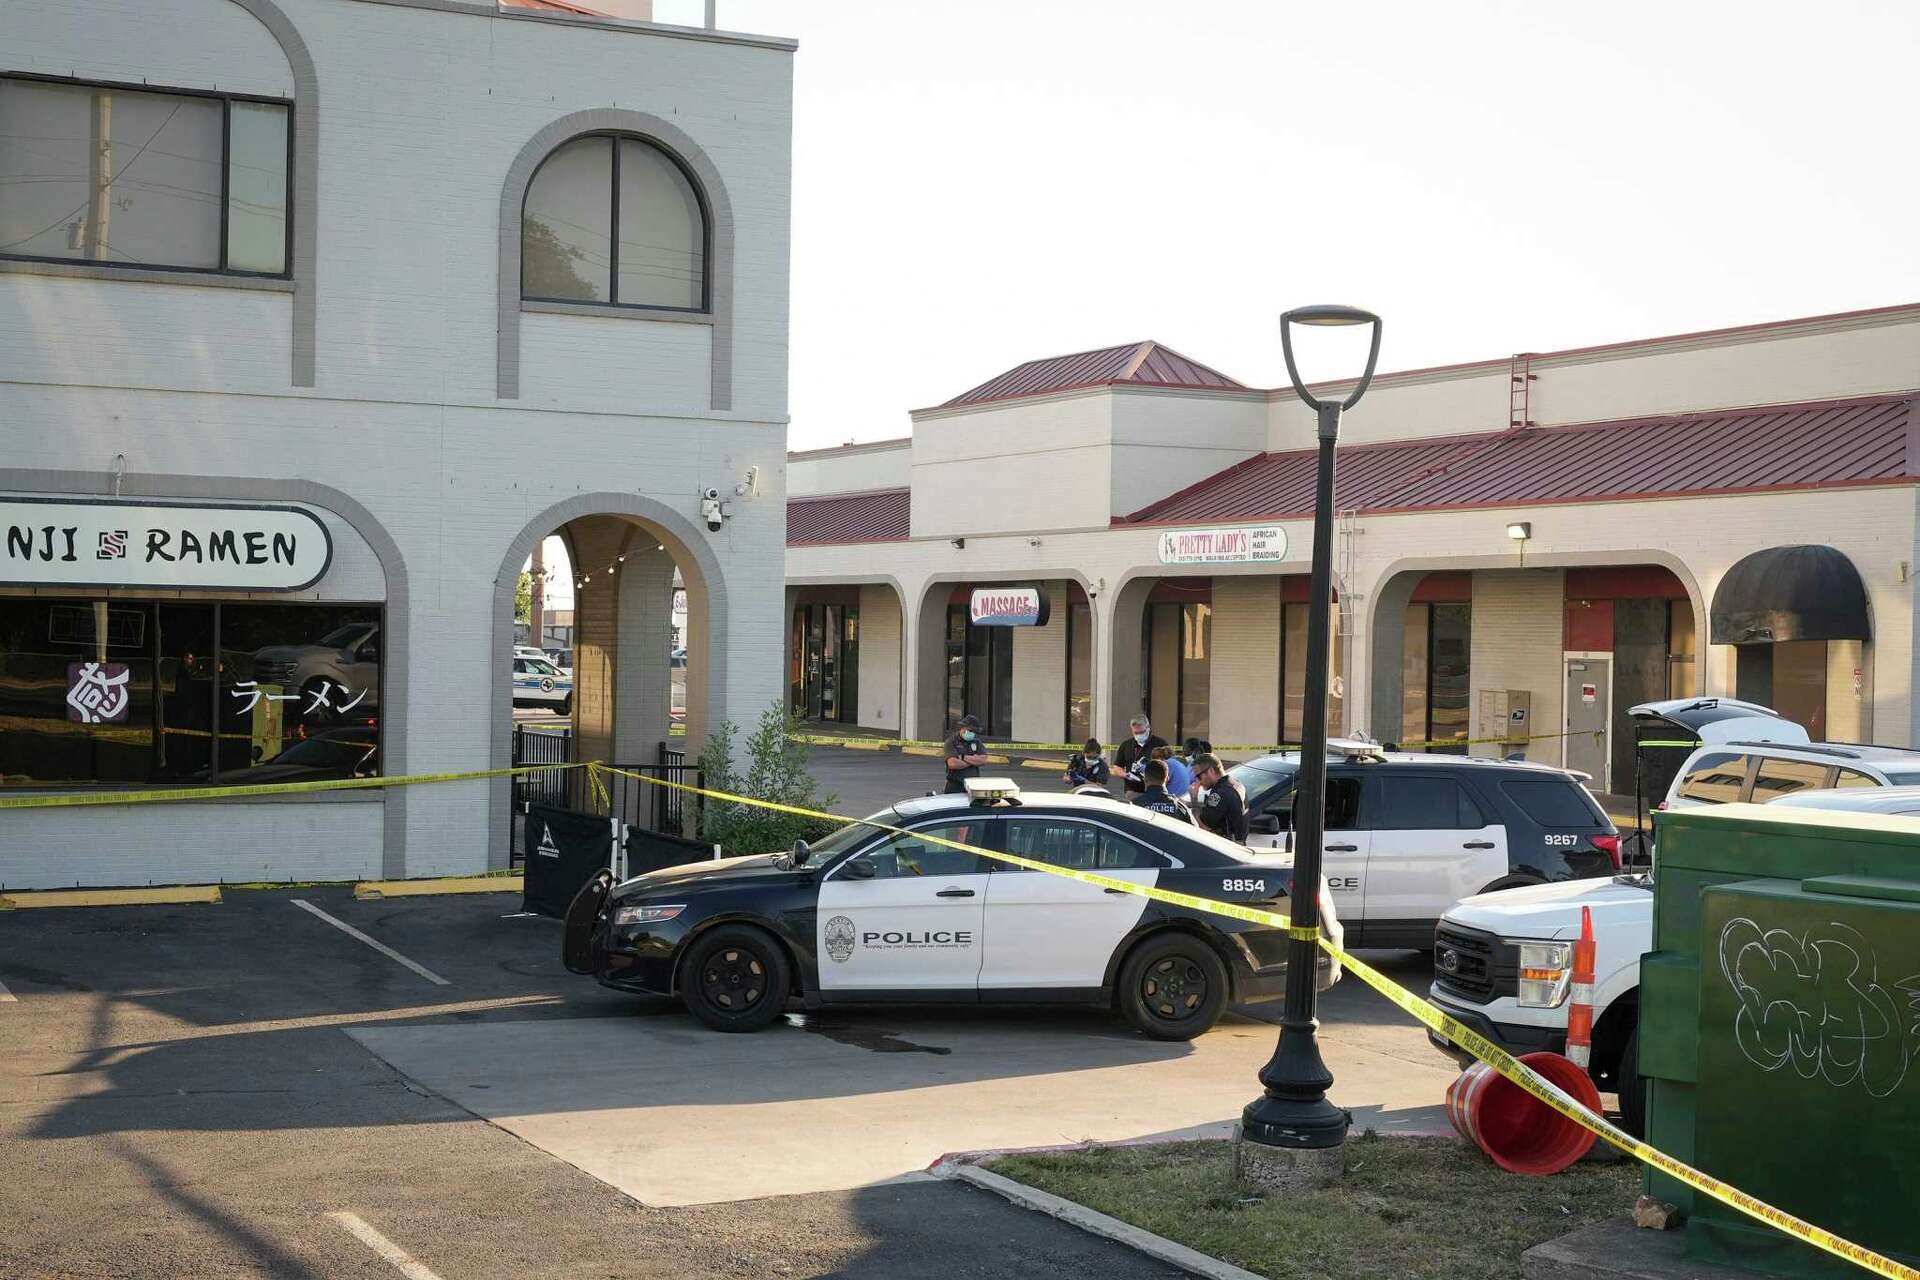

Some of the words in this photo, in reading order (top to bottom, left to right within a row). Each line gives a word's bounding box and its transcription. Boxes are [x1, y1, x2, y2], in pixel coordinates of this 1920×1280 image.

[1252, 530, 1277, 539] AFRICAN
[145, 528, 297, 567] RAMEN
[1179, 535, 1213, 554] PRETTY
[1215, 529, 1247, 553] LADY'S
[1252, 541, 1266, 549] HAIR
[1252, 551, 1280, 559] BRAIDING
[981, 596, 1029, 616] MASSAGE
[231, 680, 368, 715] ラーメン
[1544, 834, 1578, 846] 9267
[1223, 879, 1265, 892] 8854
[863, 931, 972, 943] POLICE
[1463, 1031, 1479, 1052] POLICE
